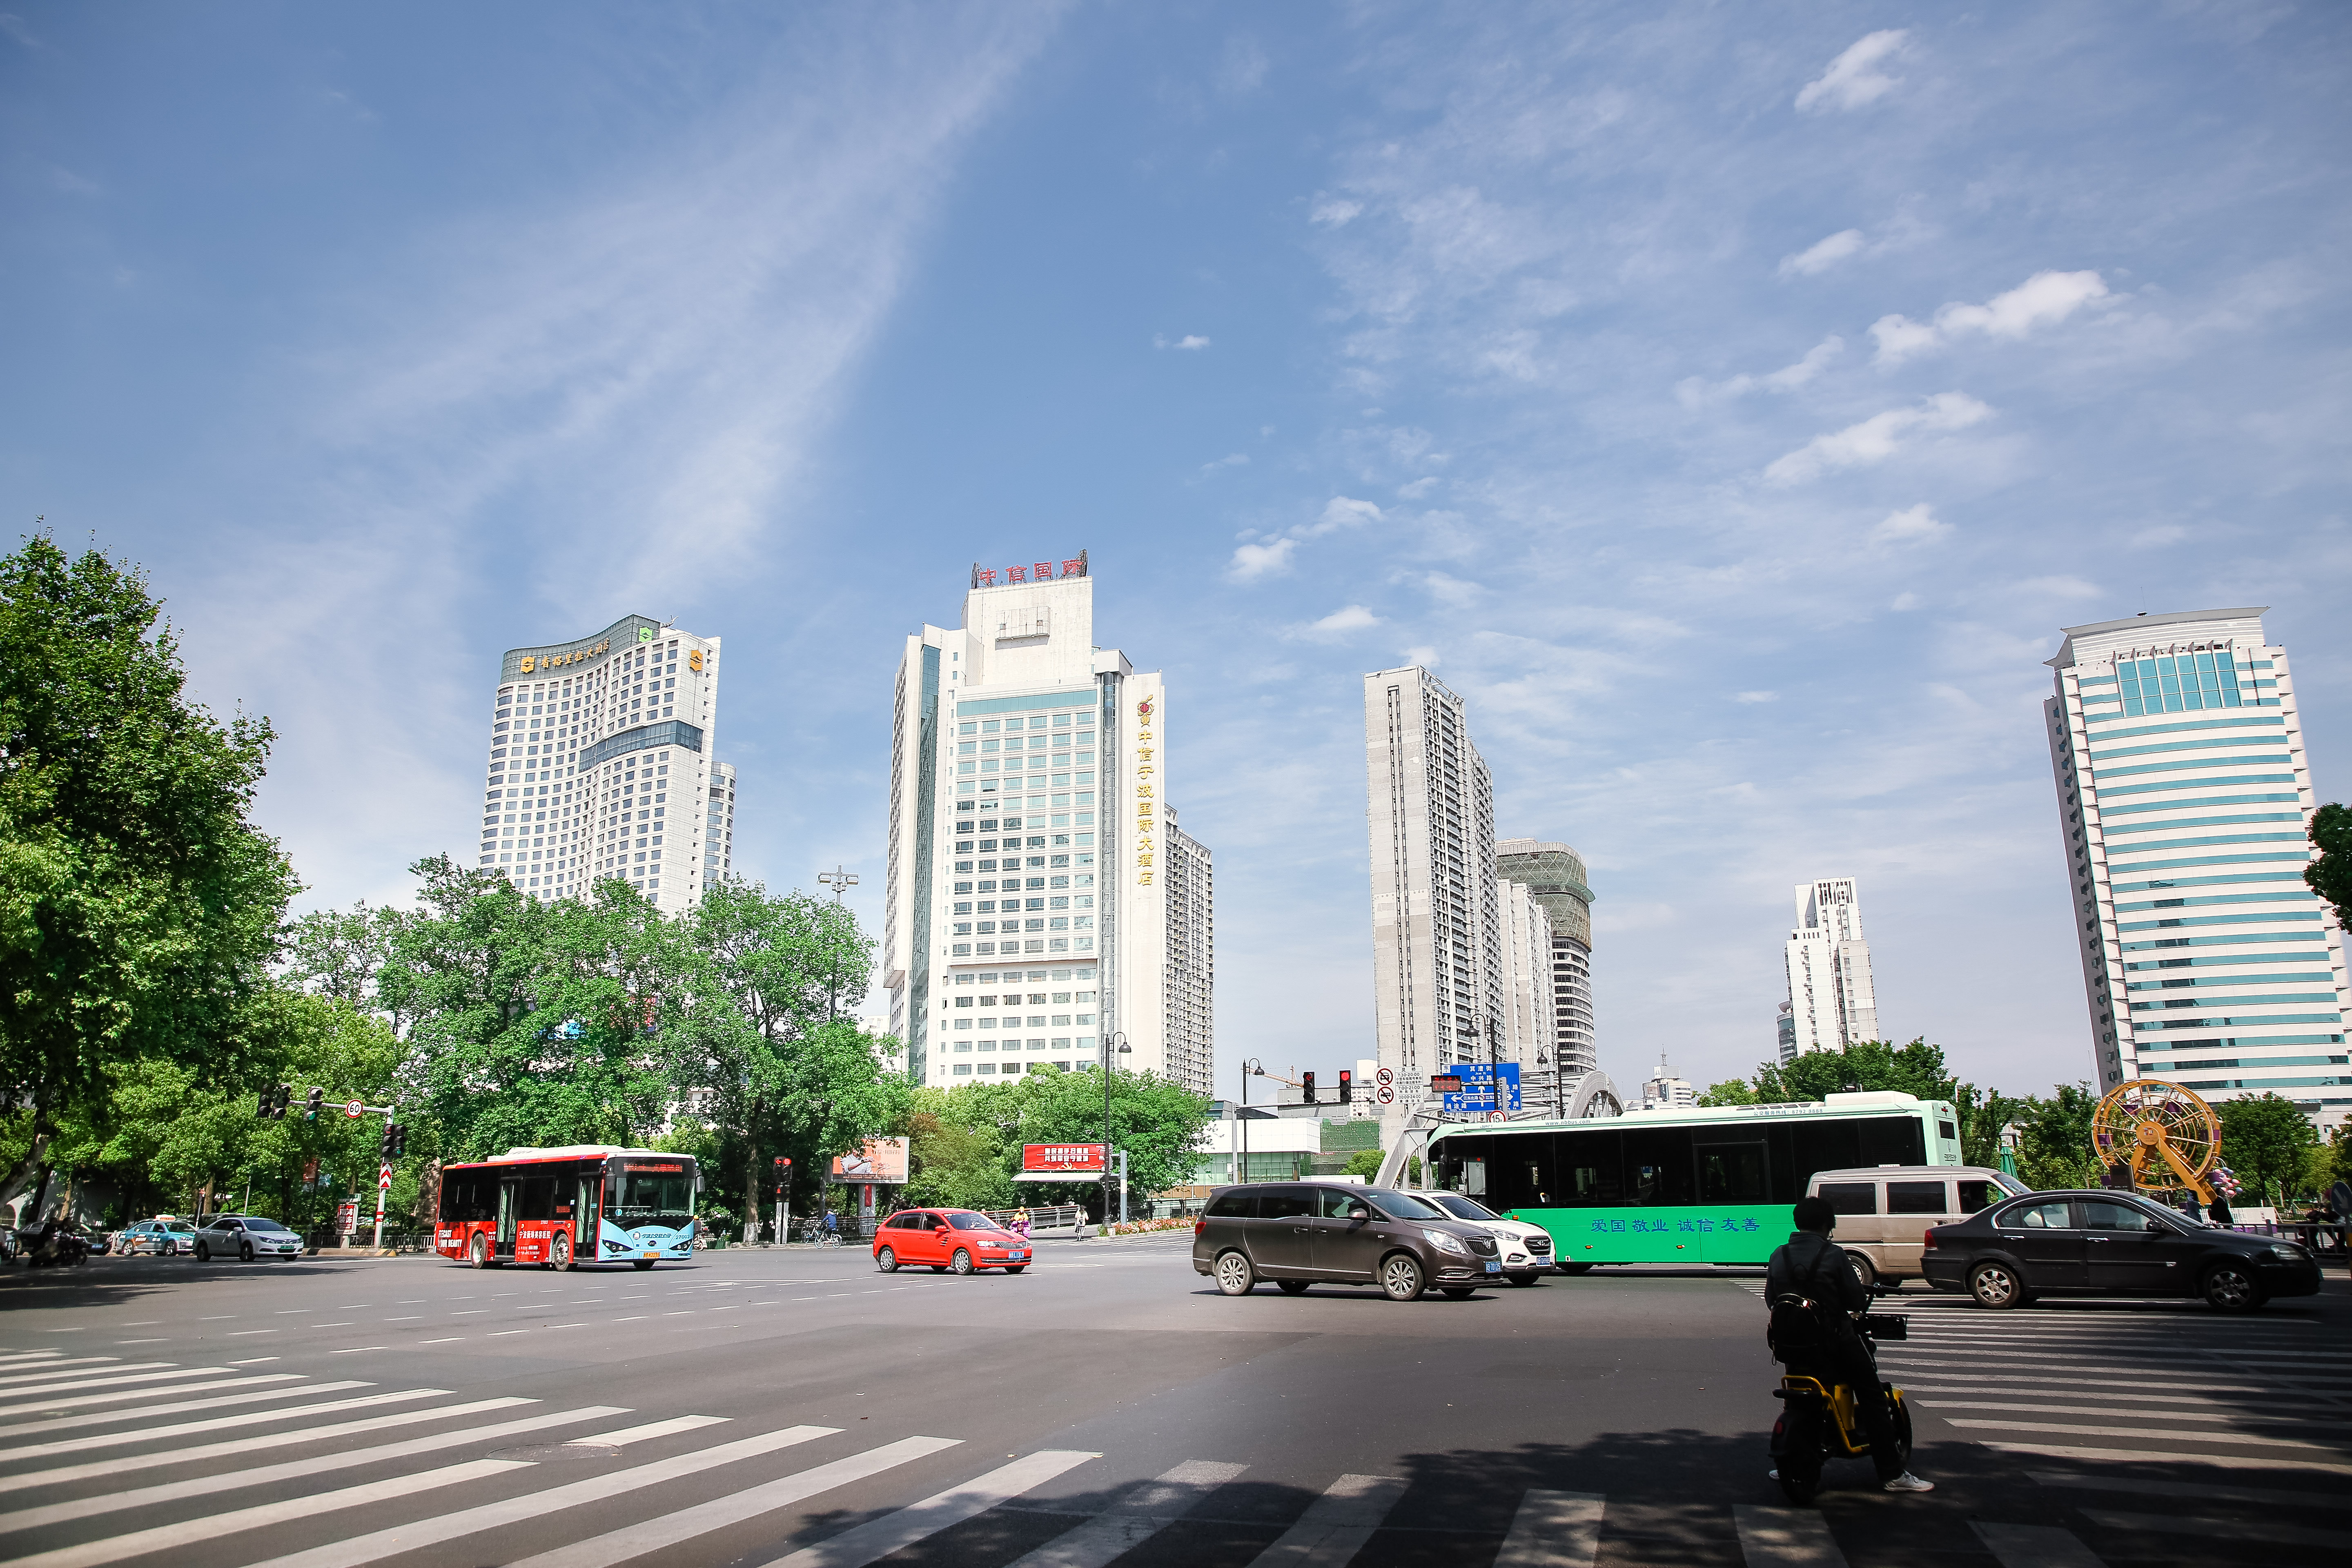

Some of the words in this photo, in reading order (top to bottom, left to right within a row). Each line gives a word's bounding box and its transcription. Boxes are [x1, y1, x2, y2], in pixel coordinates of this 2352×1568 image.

[980, 559, 1083, 584] 中信国际
[541, 637, 610, 668] 香格里拉大酒店
[1137, 729, 1154, 886] 中信宁波国际大酒店
[350, 1104, 359, 1113] 60
[1591, 1218, 1626, 1232] 爱国
[1632, 1218, 1669, 1232] 敬业
[1677, 1218, 1715, 1232] 诚信
[1720, 1217, 1760, 1232] 友善
[448, 1239, 463, 1247] BEAUTY
